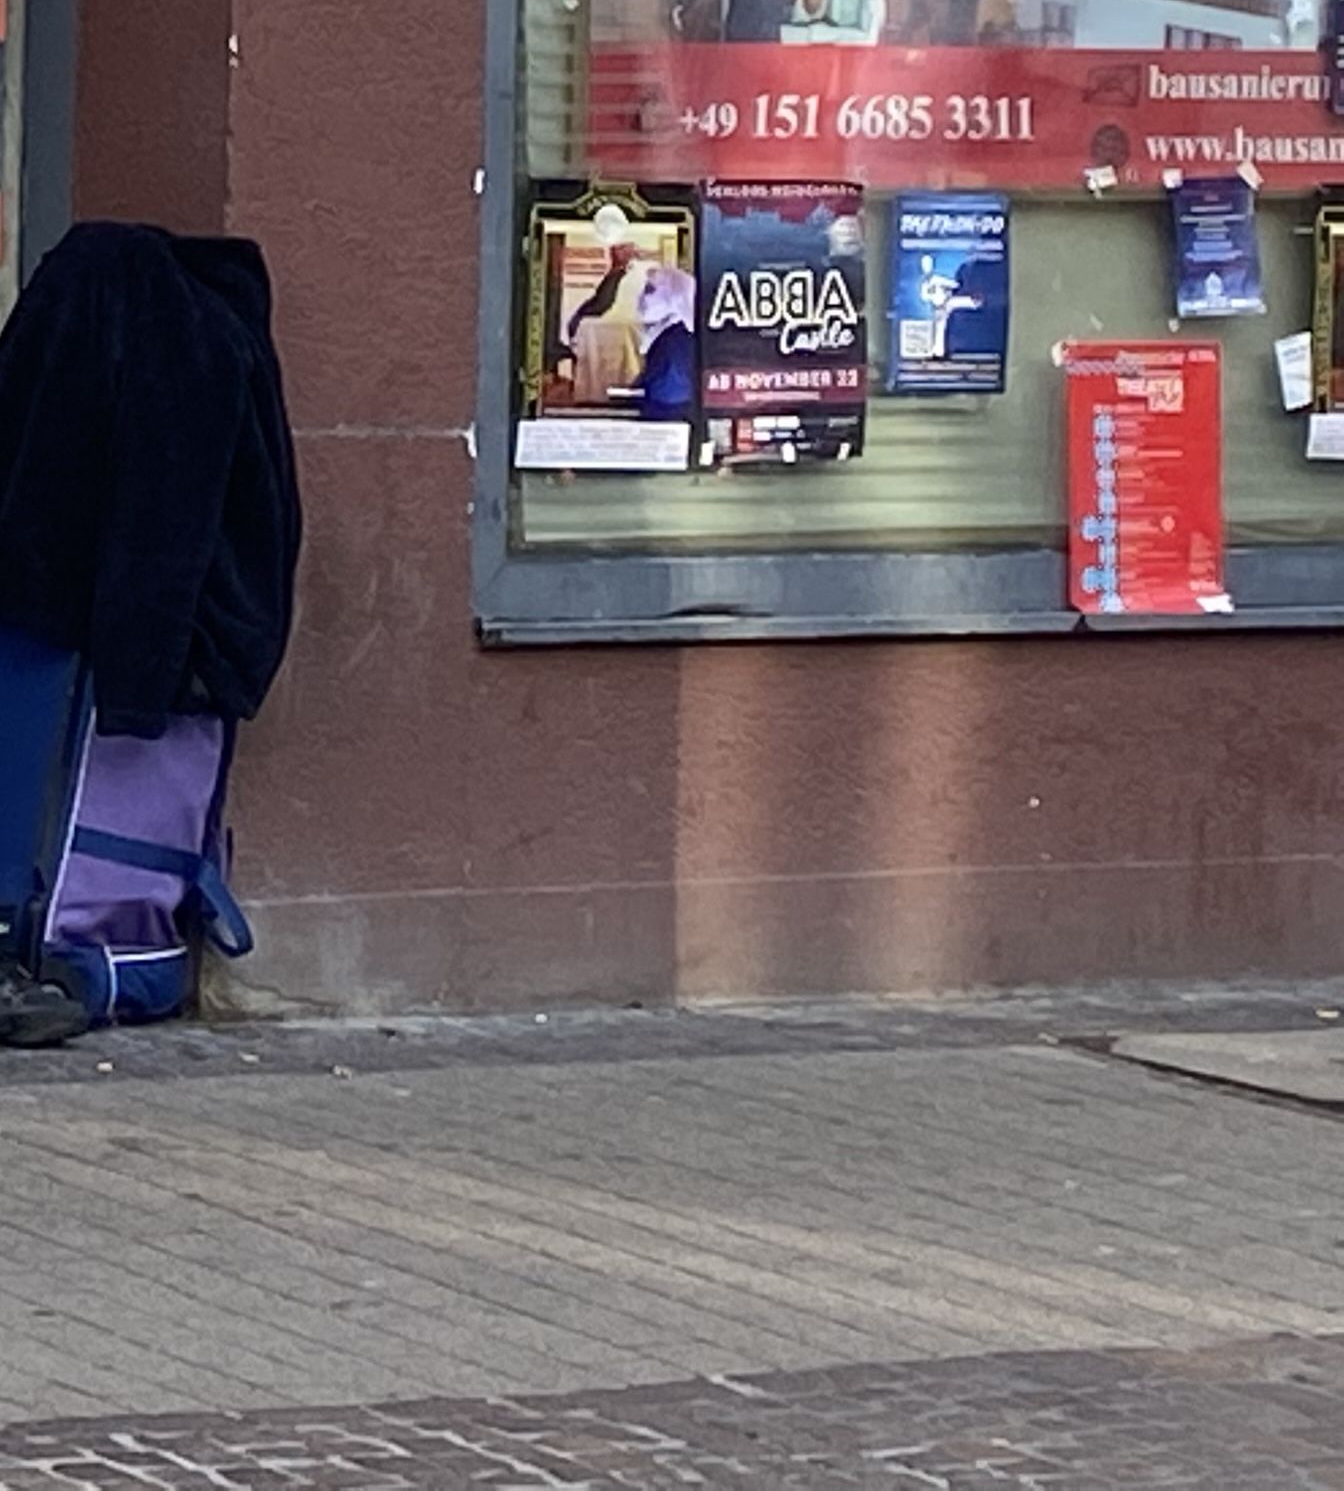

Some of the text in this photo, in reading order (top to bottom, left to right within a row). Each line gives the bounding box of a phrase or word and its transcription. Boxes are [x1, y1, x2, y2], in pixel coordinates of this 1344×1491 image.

[680, 93, 1036, 141] +49 151 6685 3311
[708, 269, 858, 328] ABBA
[735, 370, 831, 390] NOVEMBER
